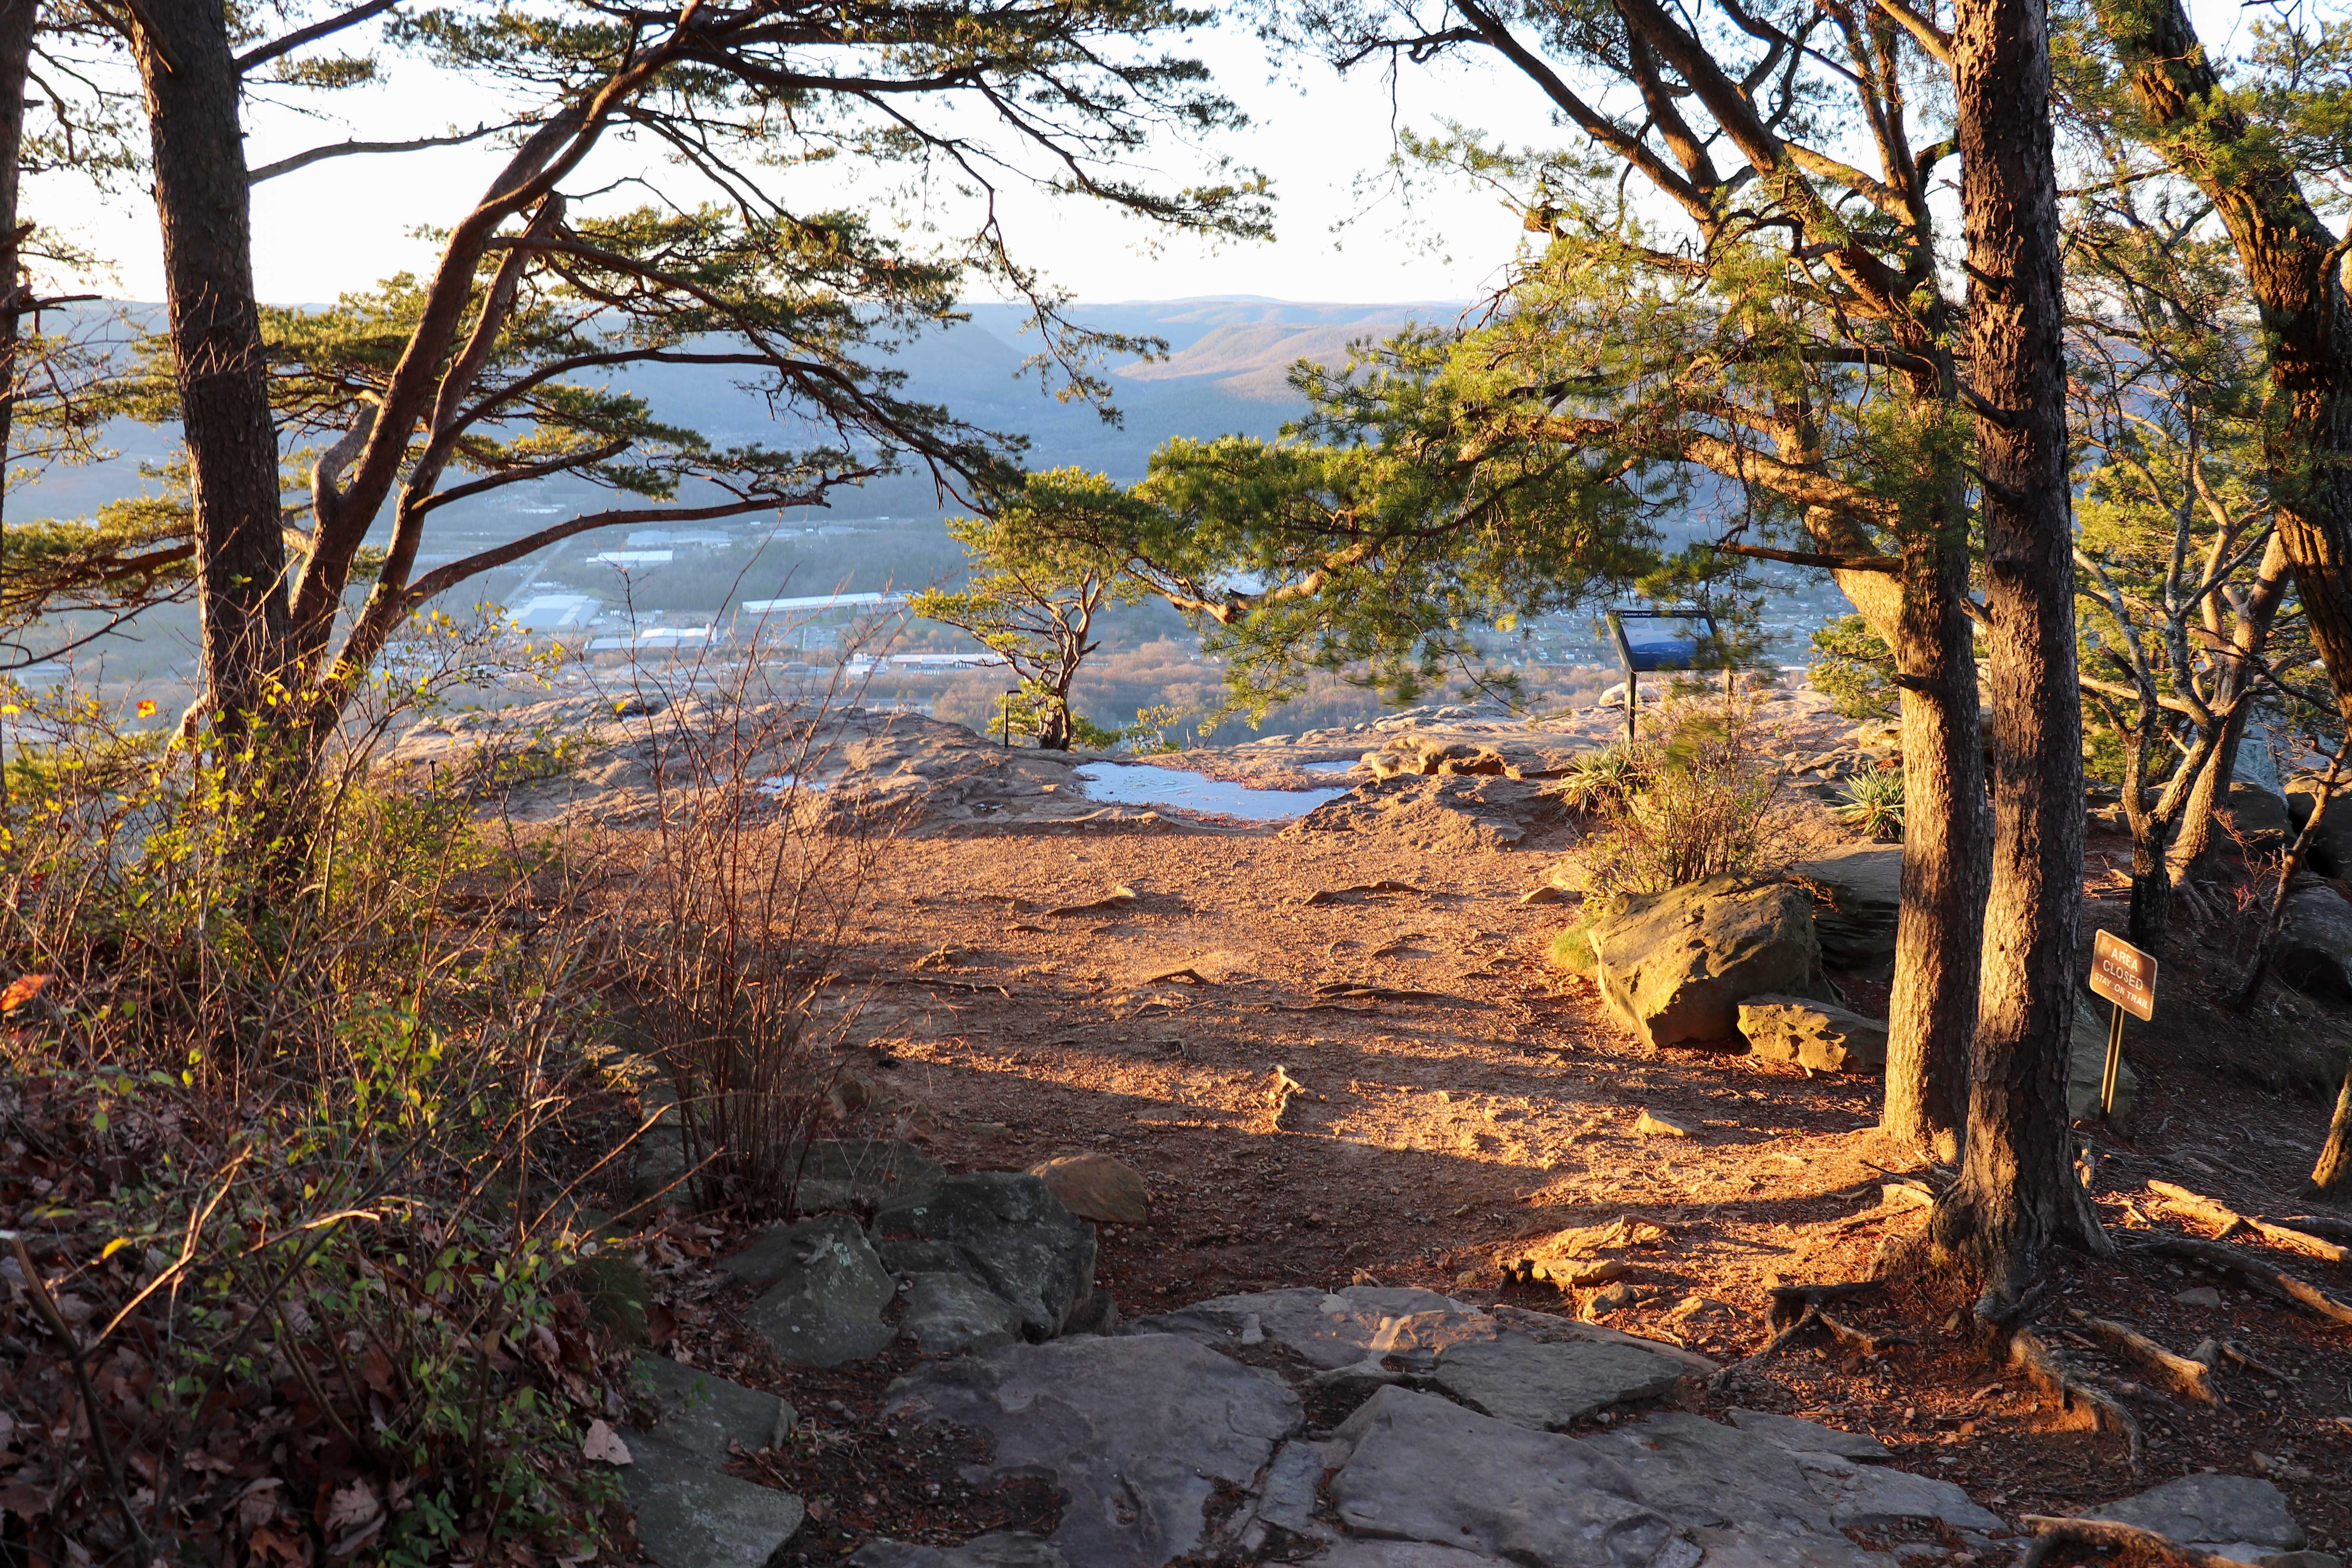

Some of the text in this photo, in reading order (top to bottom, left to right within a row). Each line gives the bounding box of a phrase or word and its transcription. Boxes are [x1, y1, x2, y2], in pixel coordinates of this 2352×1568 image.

[2111, 947, 2138, 972] AREA
[2094, 972, 2149, 1009] STAY ON TRAIL
[2103, 960, 2143, 991] CLOSED
